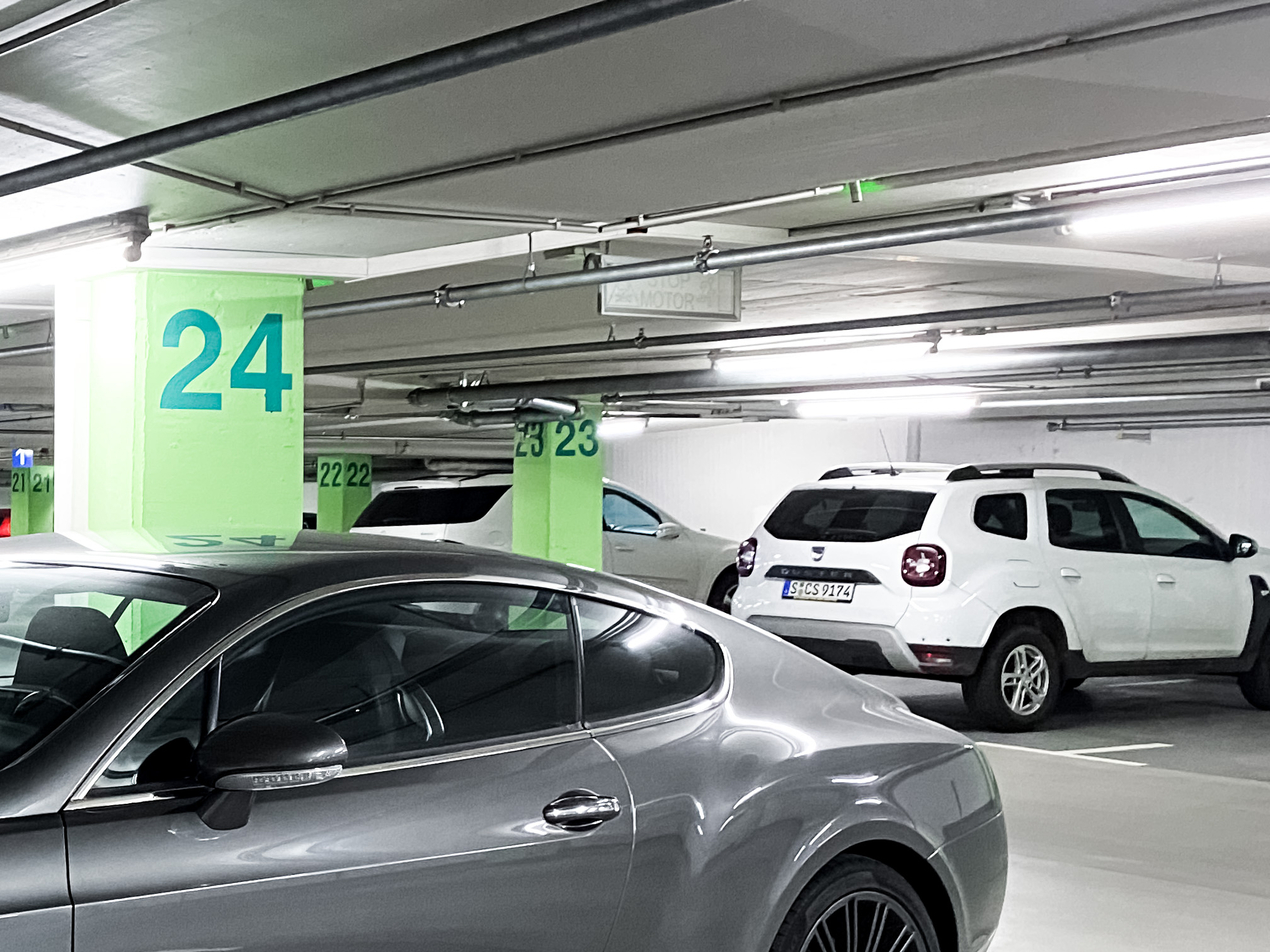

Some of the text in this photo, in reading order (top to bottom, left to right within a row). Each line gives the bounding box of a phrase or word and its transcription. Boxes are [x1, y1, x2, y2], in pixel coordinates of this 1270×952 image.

[640, 290, 695, 311] MOTOR
[160, 309, 292, 414] 24
[555, 419, 599, 457] 23
[12, 472, 25, 492] 21
[33, 473, 50, 493] 21
[320, 462, 342, 487] 22
[347, 462, 370, 487] 22
[822, 584, 851, 597] 9174
